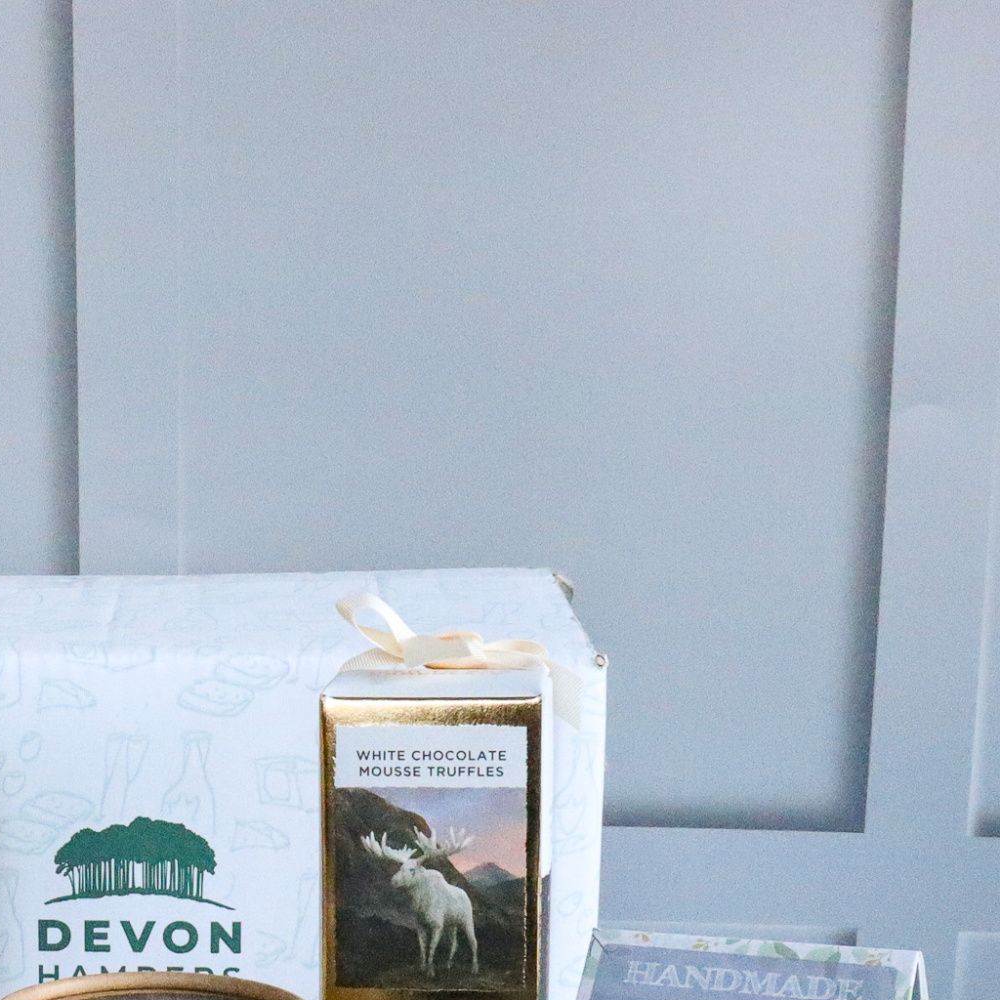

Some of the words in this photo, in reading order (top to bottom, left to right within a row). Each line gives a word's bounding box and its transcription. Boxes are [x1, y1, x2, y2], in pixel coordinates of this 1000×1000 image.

[356, 750, 406, 761] WHITE
[411, 750, 507, 761] CHOCOLATE
[359, 766, 421, 777] MOUSSE
[427, 766, 504, 777] TRUFFLES
[38, 919, 242, 954] DEVON
